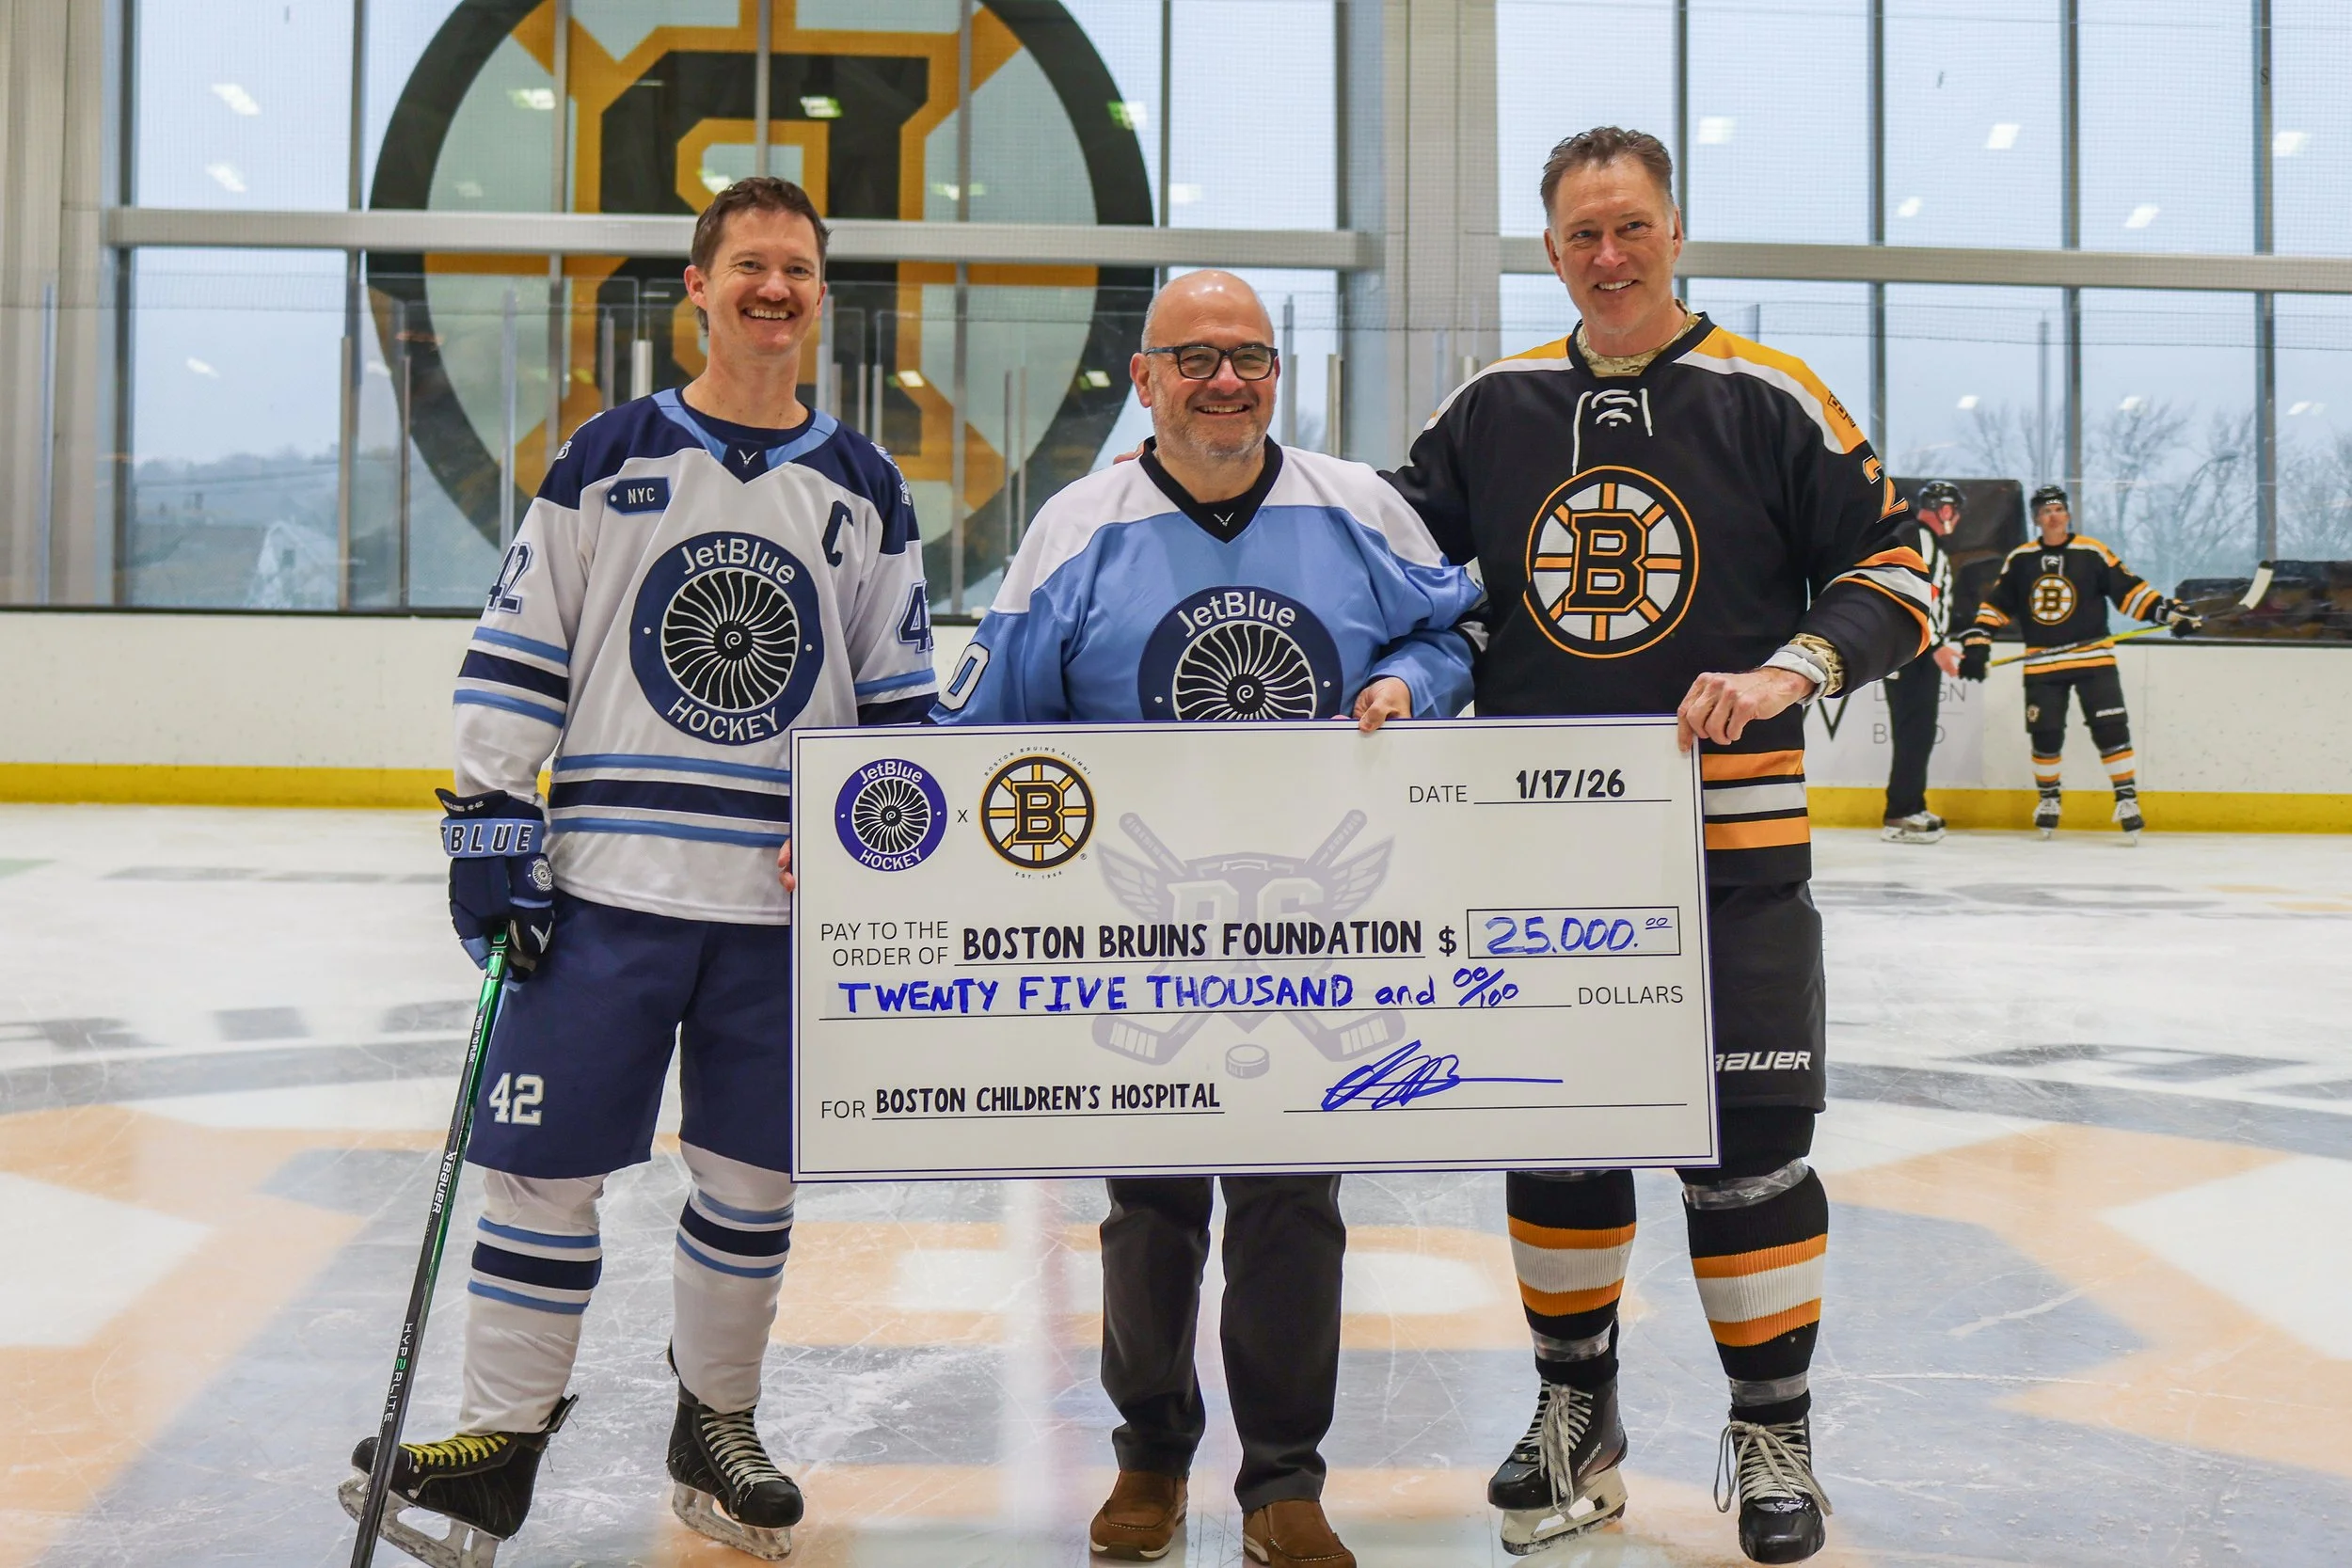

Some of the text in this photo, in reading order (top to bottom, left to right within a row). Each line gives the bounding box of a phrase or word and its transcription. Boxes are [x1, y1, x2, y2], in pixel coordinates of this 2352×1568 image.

[628, 487, 657, 504] NYC
[821, 500, 854, 567] C
[487, 542, 532, 615] 42
[681, 538, 796, 584] JetBlue
[1565, 510, 1647, 614] B
[896, 578, 934, 654] 4
[1177, 591, 1296, 639] JetBlue
[667, 697, 780, 741] HOCKEY
[859, 761, 923, 784] JetBlue
[1061, 751, 1091, 775] ALUMNI
[1409, 768, 1626, 803] DATE 1/17/26
[1010, 779, 1066, 845] B
[859, 847, 923, 870] HOCKEY
[821, 921, 948, 942] PAY TO THE
[833, 920, 1457, 967] ORDER OF BOSTON BRUINS FOUNDATION $
[838, 978, 999, 1014] TWENTY
[1019, 975, 1127, 1011] FIVE
[1146, 974, 1354, 1009] THOUSAND
[1375, 974, 1436, 1006] and
[1578, 985, 1683, 1005] DOLLARS
[487, 1071, 545, 1126] 42
[821, 1083, 1221, 1118] FOR BOSTON CHILDREN'S HOSPITAL
[432, 1161, 453, 1214] BAUER
[384, 1323, 413, 1423] HYP2RLITE
